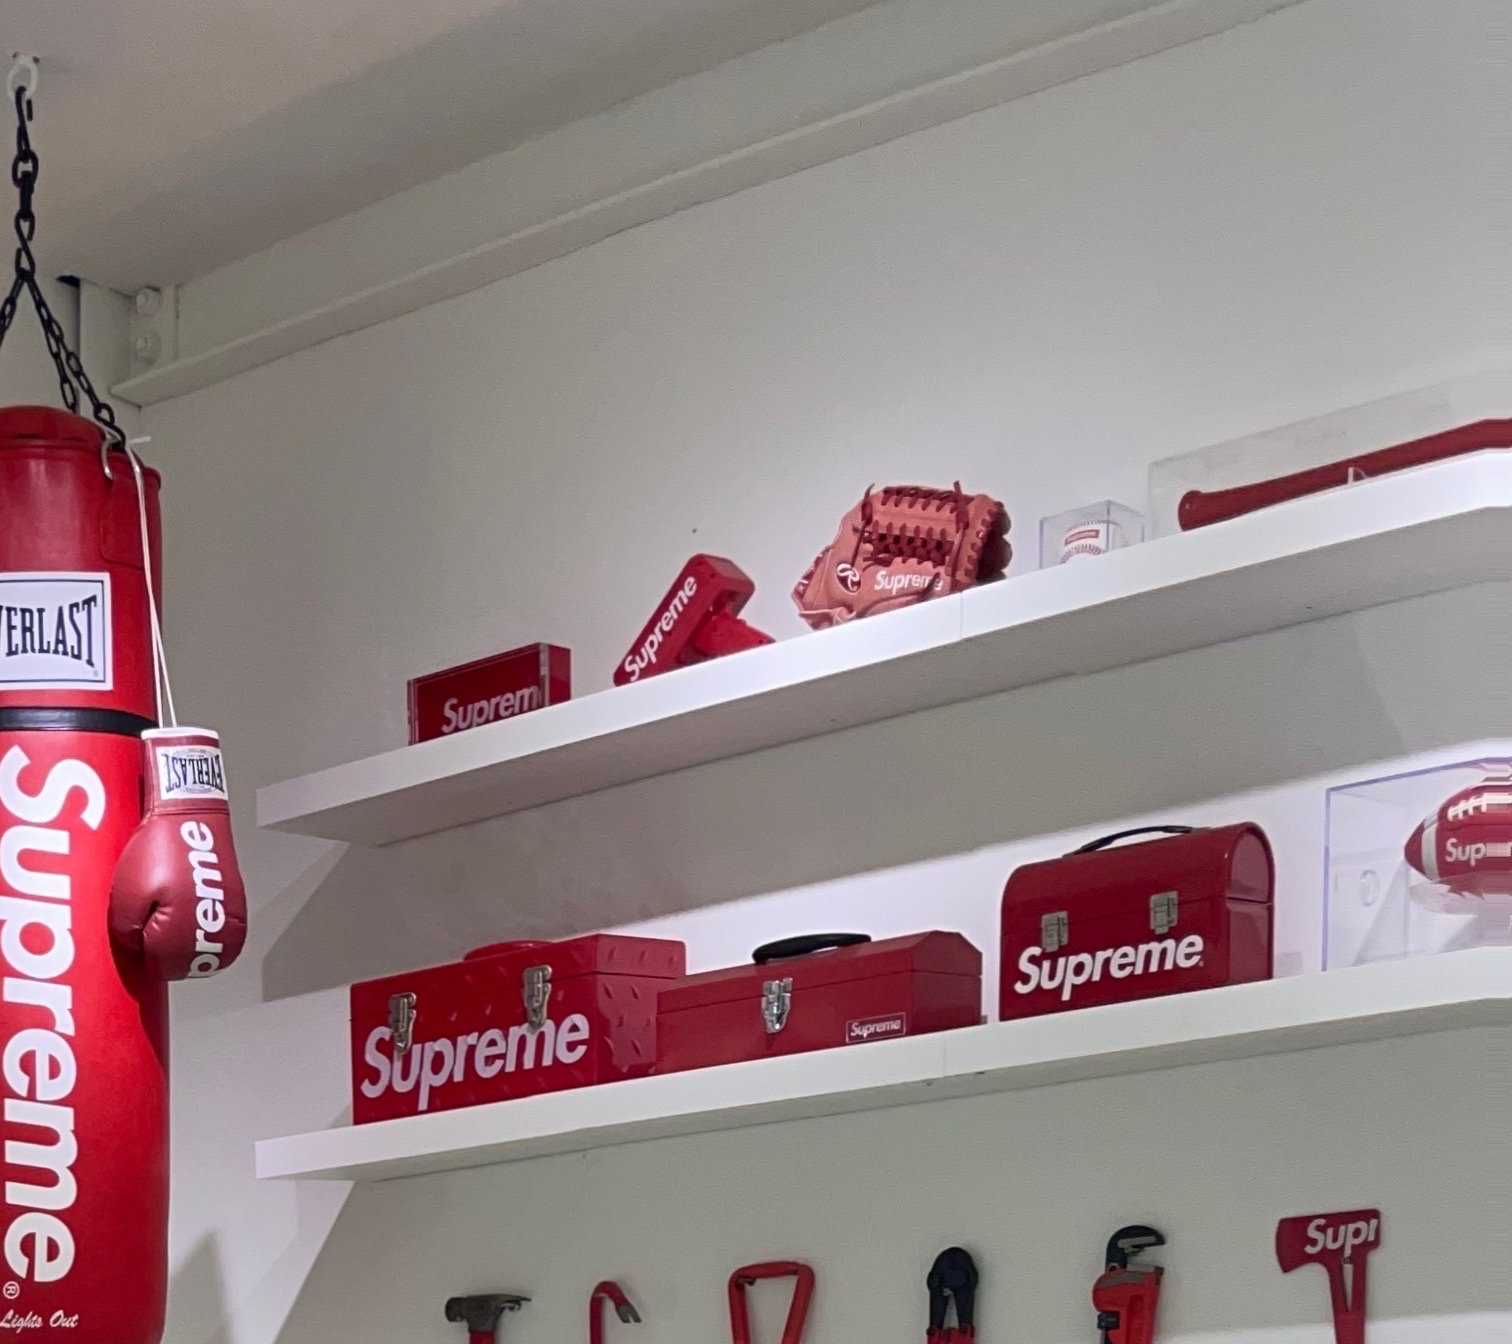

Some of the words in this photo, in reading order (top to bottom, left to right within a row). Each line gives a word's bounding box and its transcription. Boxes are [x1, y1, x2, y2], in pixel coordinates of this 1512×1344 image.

[874, 571, 943, 595] Supreme
[623, 574, 697, 682] Supreme
[161, 754, 225, 793] EVERLAST
[1014, 934, 1204, 1001] Supreme
[850, 1020, 901, 1038] Supreme
[360, 1013, 589, 1111] Supreme
[49, 1309, 79, 1328] Out
